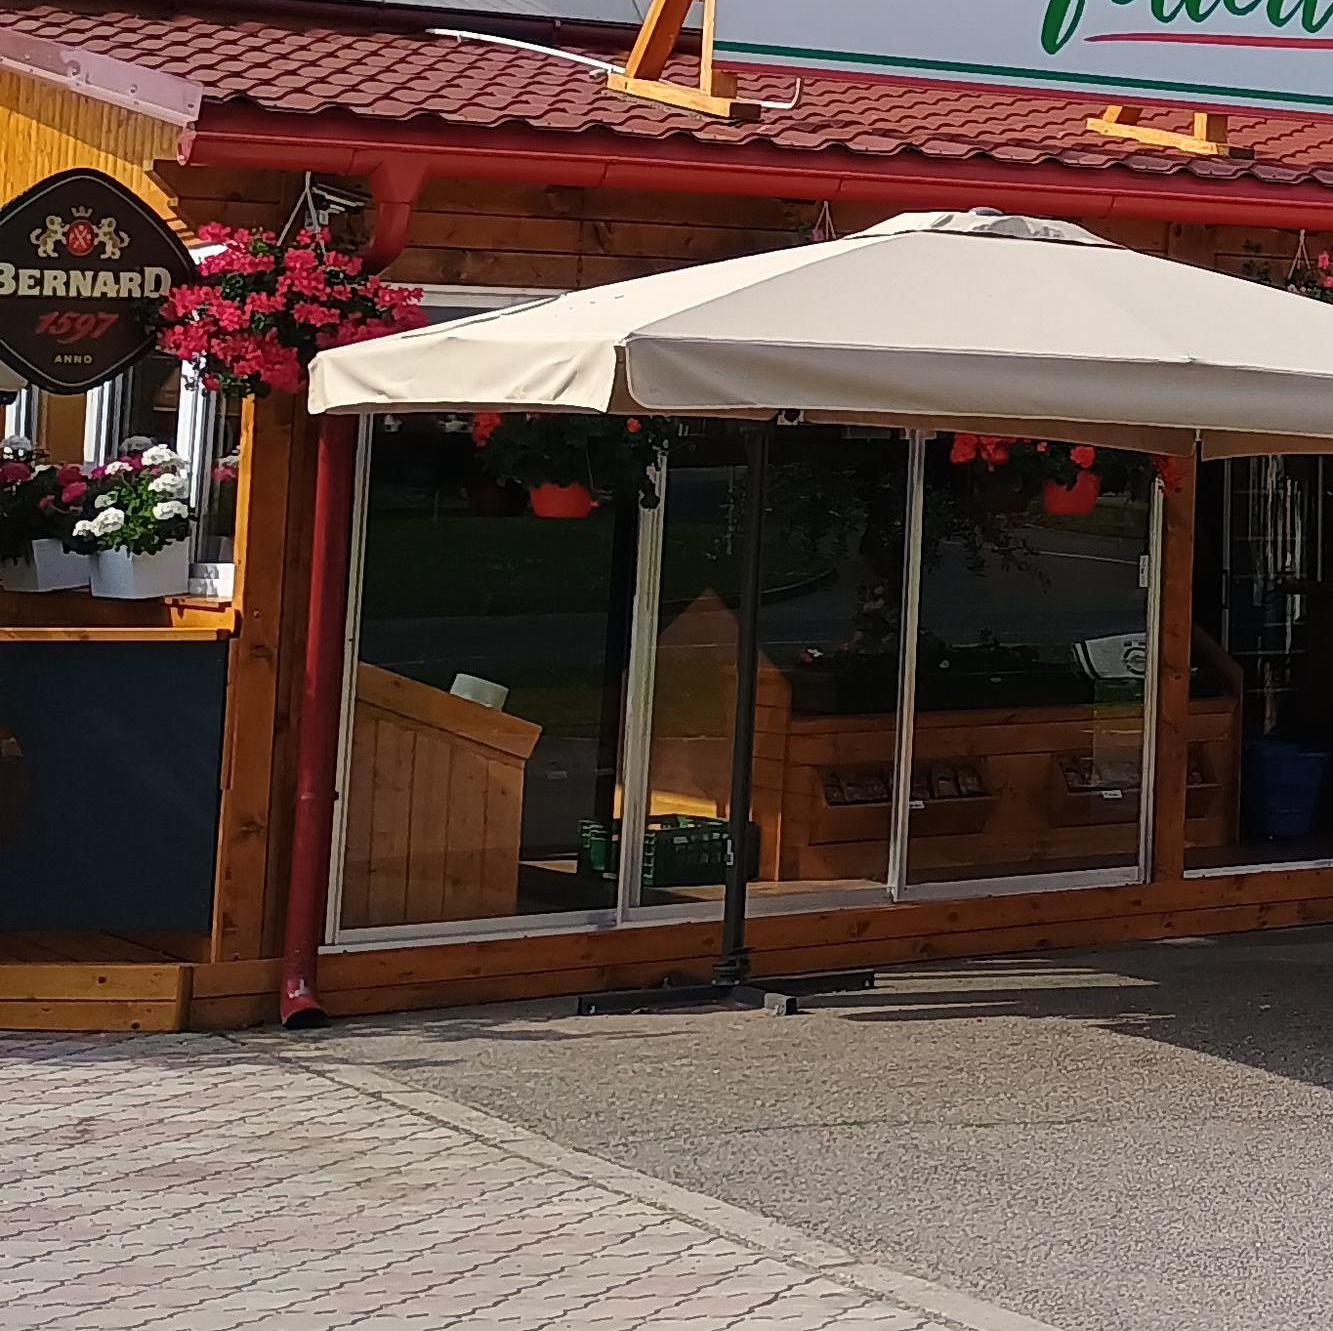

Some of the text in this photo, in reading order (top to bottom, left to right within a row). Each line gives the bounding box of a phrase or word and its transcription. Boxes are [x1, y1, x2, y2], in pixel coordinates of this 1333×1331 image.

[0, 263, 171, 298] BERNARD
[34, 310, 119, 345] 1597
[54, 354, 93, 364] ANNO
